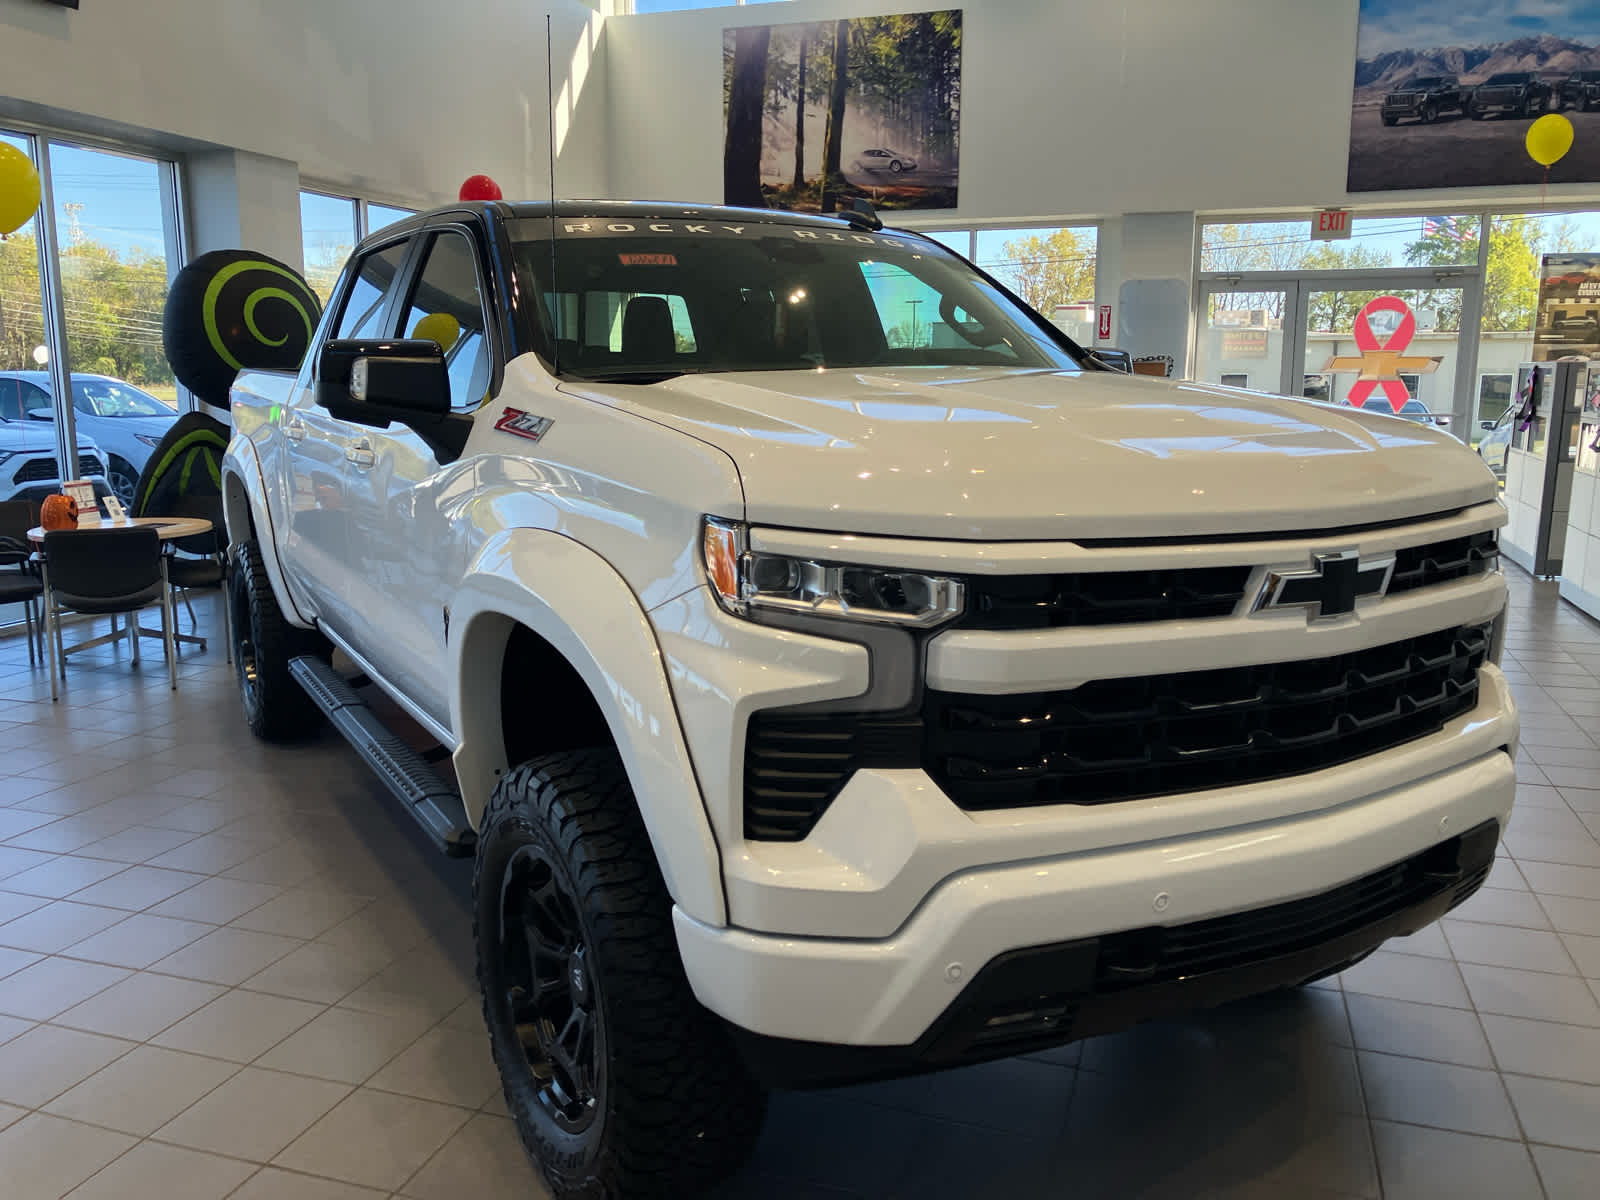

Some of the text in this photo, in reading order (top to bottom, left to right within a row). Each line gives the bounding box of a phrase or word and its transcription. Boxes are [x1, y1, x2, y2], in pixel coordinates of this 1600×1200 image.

[564, 223, 745, 234] ROCKY
[1320, 211, 1347, 231] EXIT
[494, 407, 555, 442] Z71
